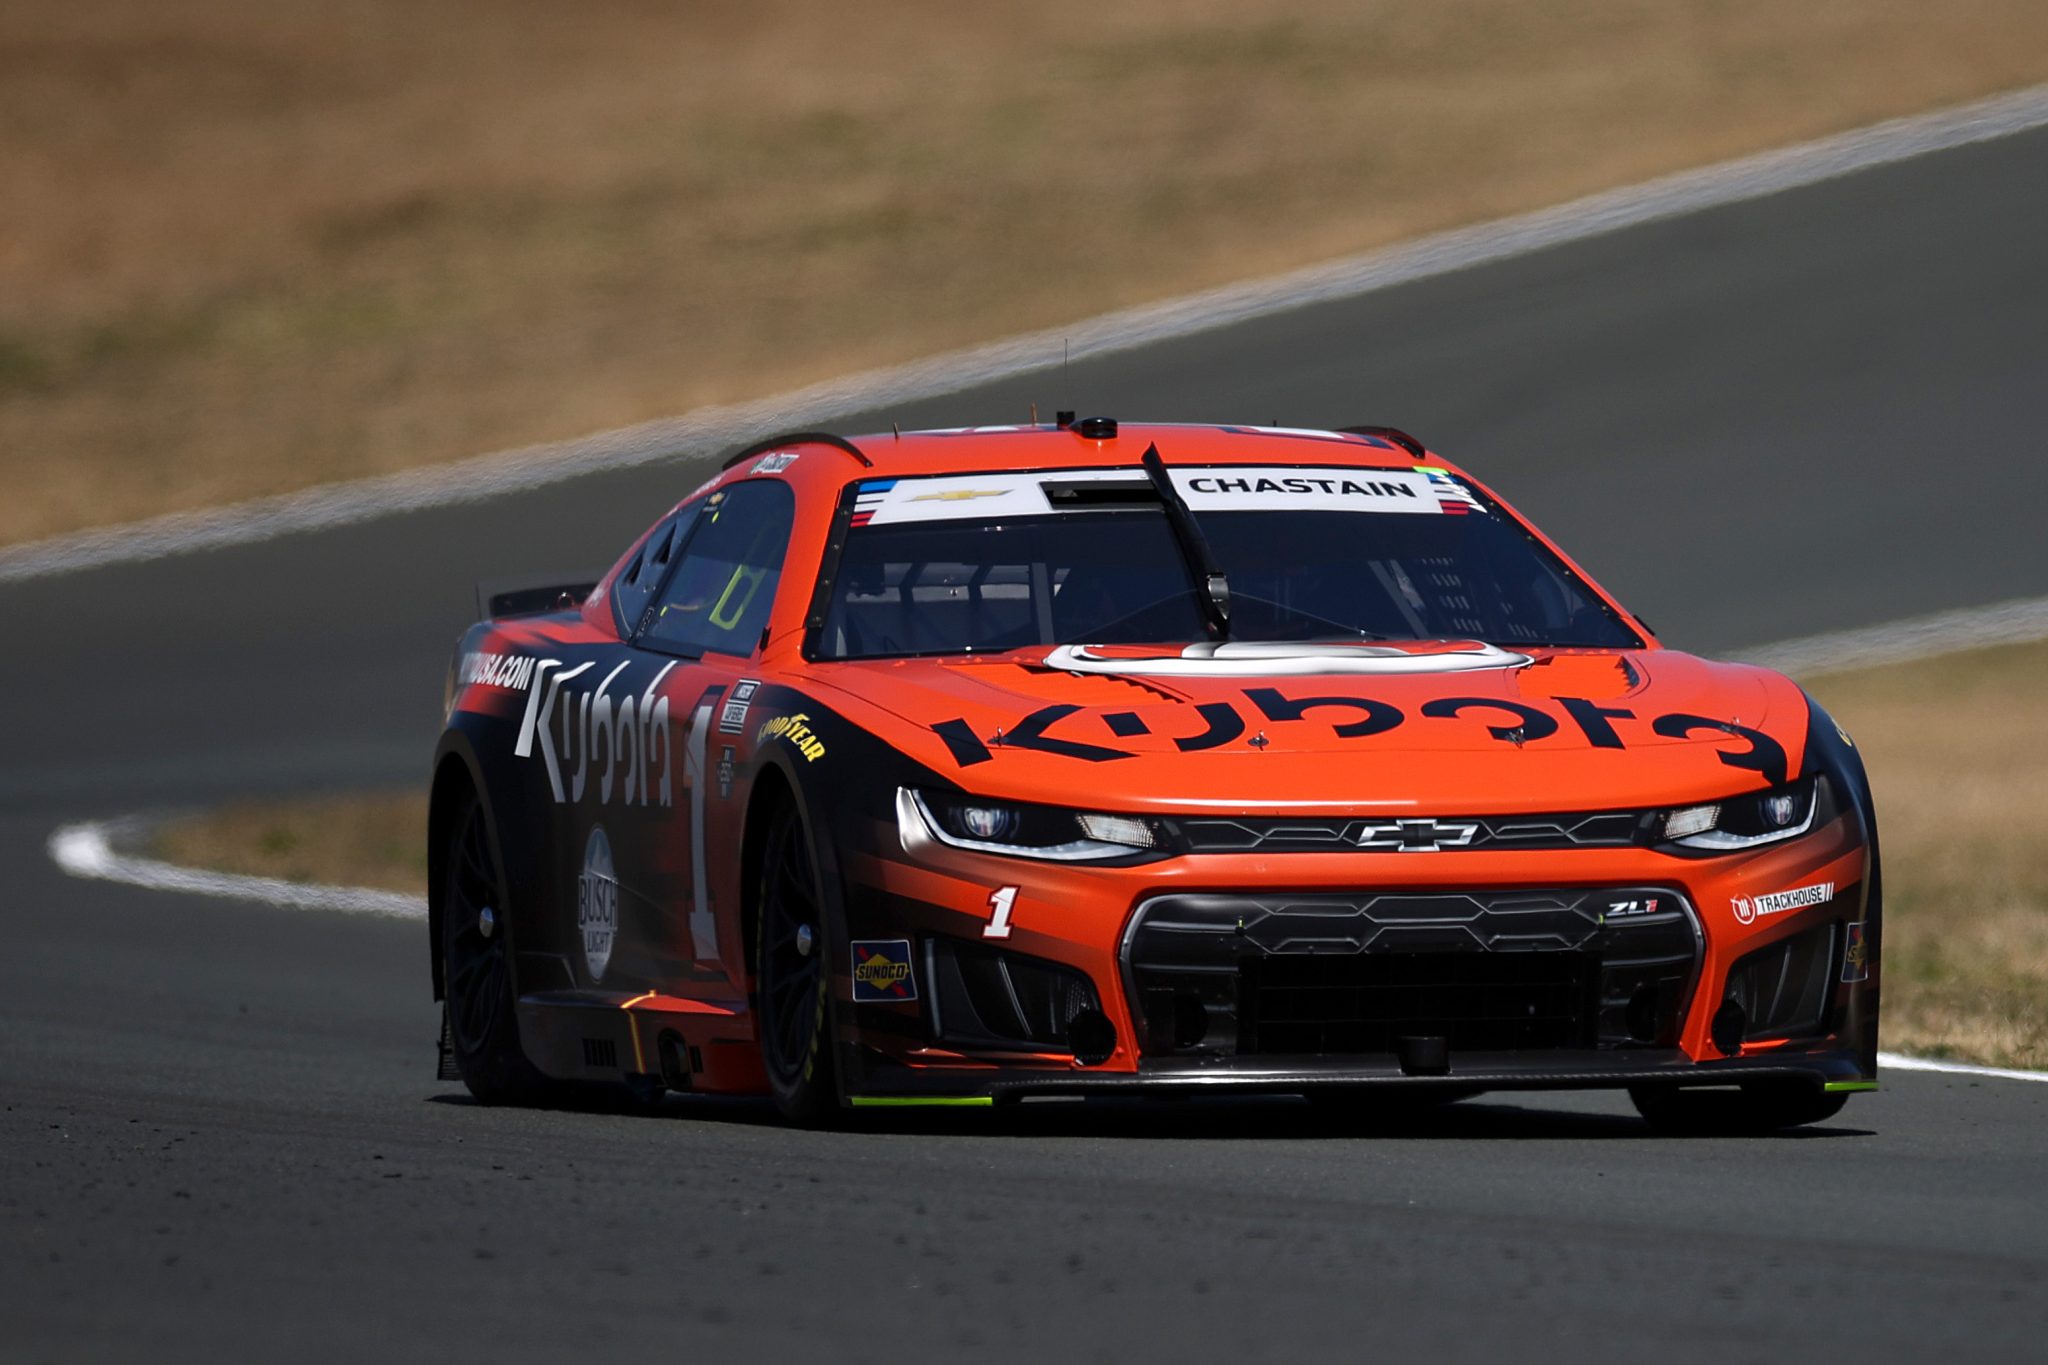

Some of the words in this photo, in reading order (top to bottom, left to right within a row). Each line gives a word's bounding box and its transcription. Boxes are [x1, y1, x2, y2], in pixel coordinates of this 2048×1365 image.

[1188, 478, 1417, 498] CHASTAIN
[514, 657, 677, 807] Kubota
[757, 712, 827, 763] GOODYEAR
[686, 704, 720, 960] 1
[579, 877, 616, 928] BUSCH
[982, 886, 1019, 940] 1
[1606, 899, 1659, 917] ZL1
[1758, 886, 1823, 913] TRACKHOUSE
[587, 930, 611, 953] LIGHT
[857, 964, 907, 980] SUNOCO
